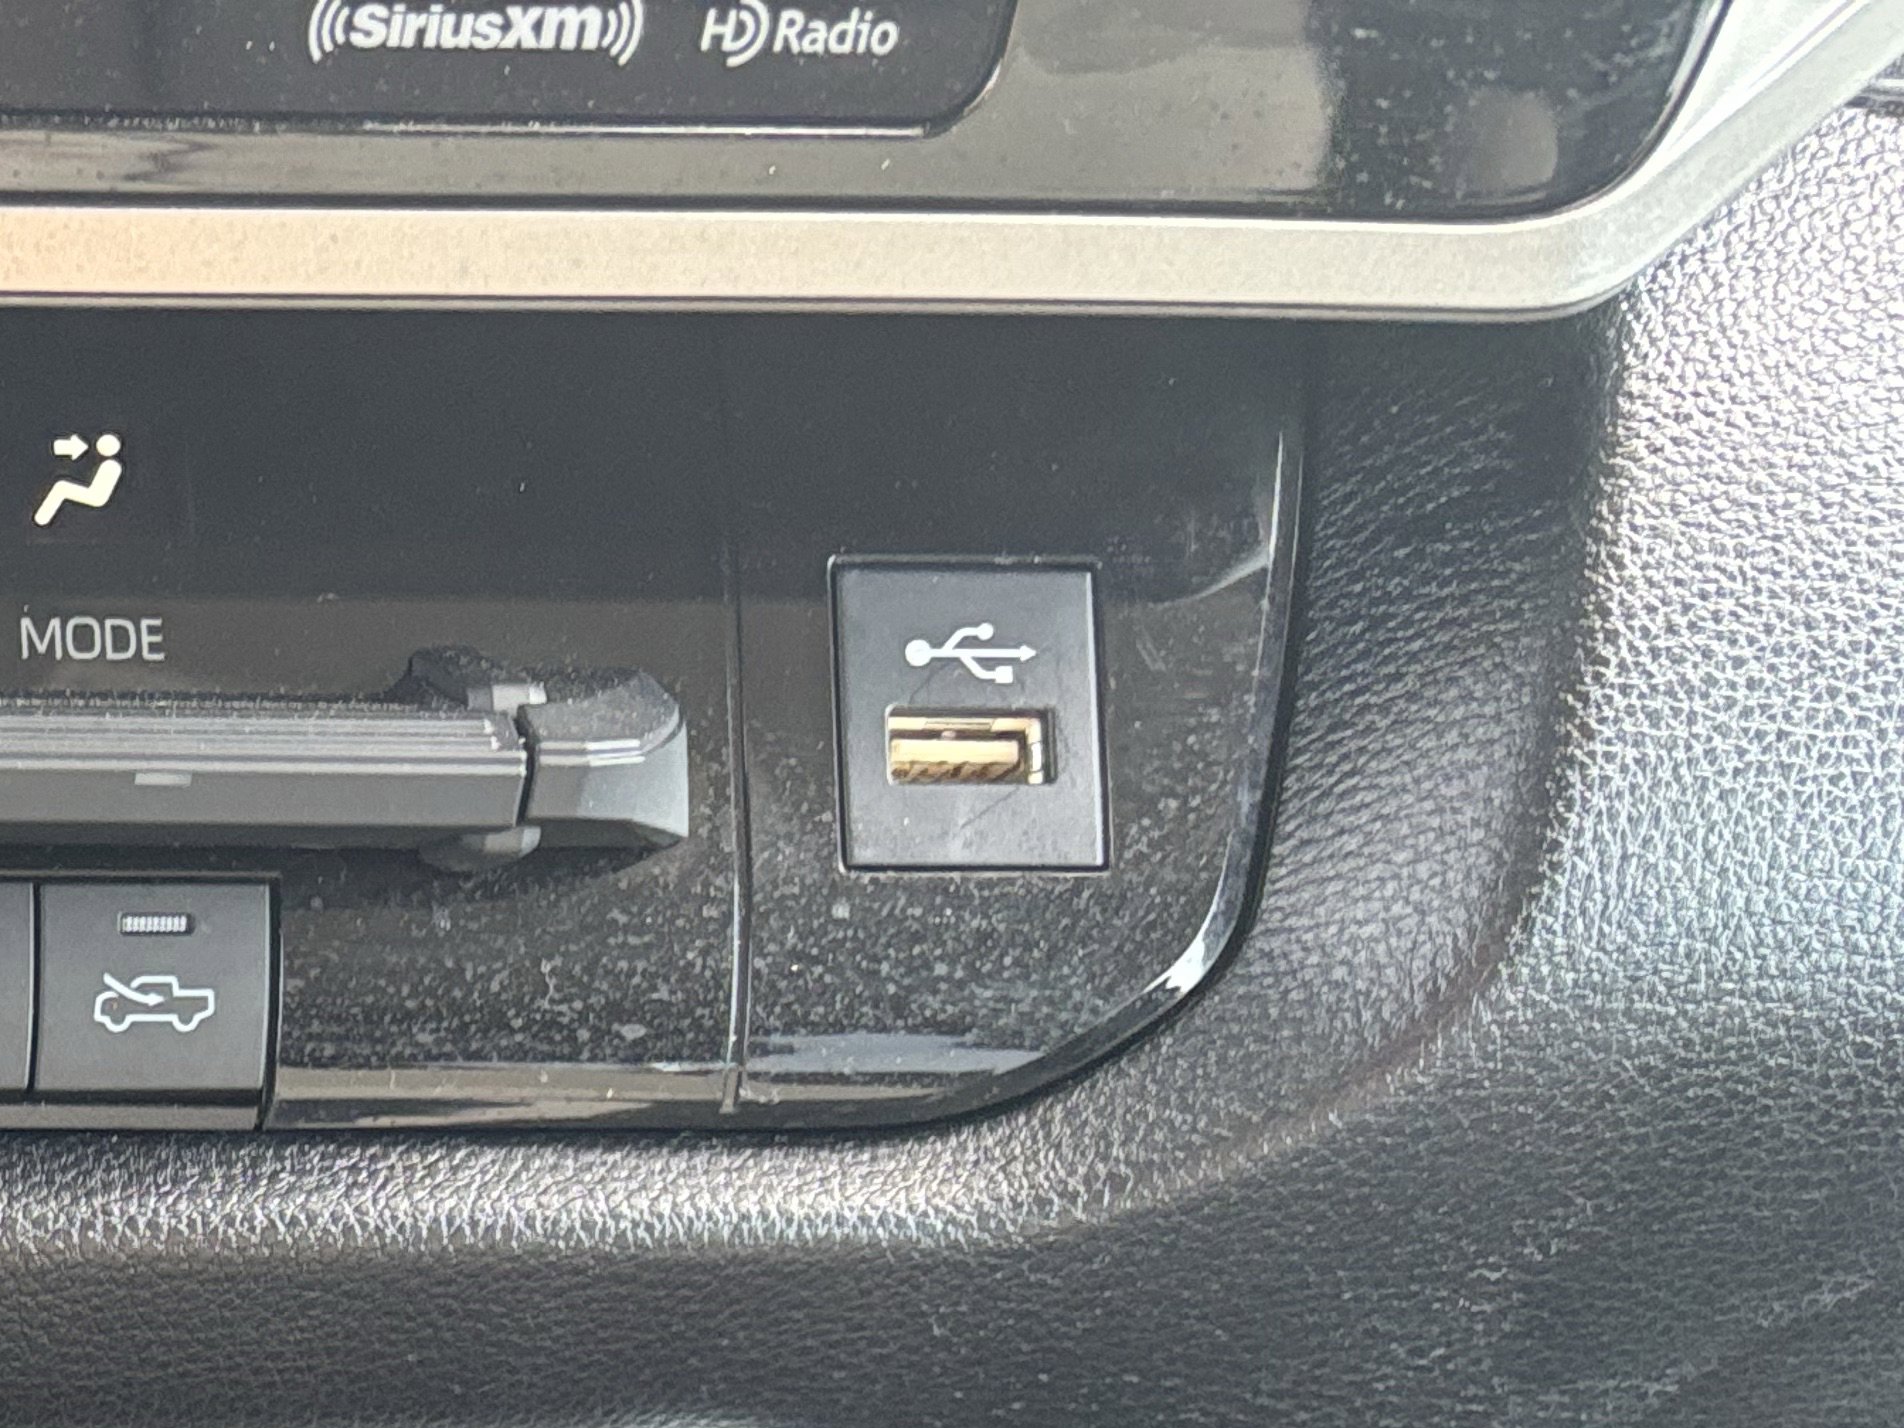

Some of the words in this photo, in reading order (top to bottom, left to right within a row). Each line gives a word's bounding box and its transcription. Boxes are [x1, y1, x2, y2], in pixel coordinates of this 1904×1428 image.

[700, 4, 765, 58] HD
[772, 8, 900, 57] Radio
[19, 616, 166, 662] MODE
